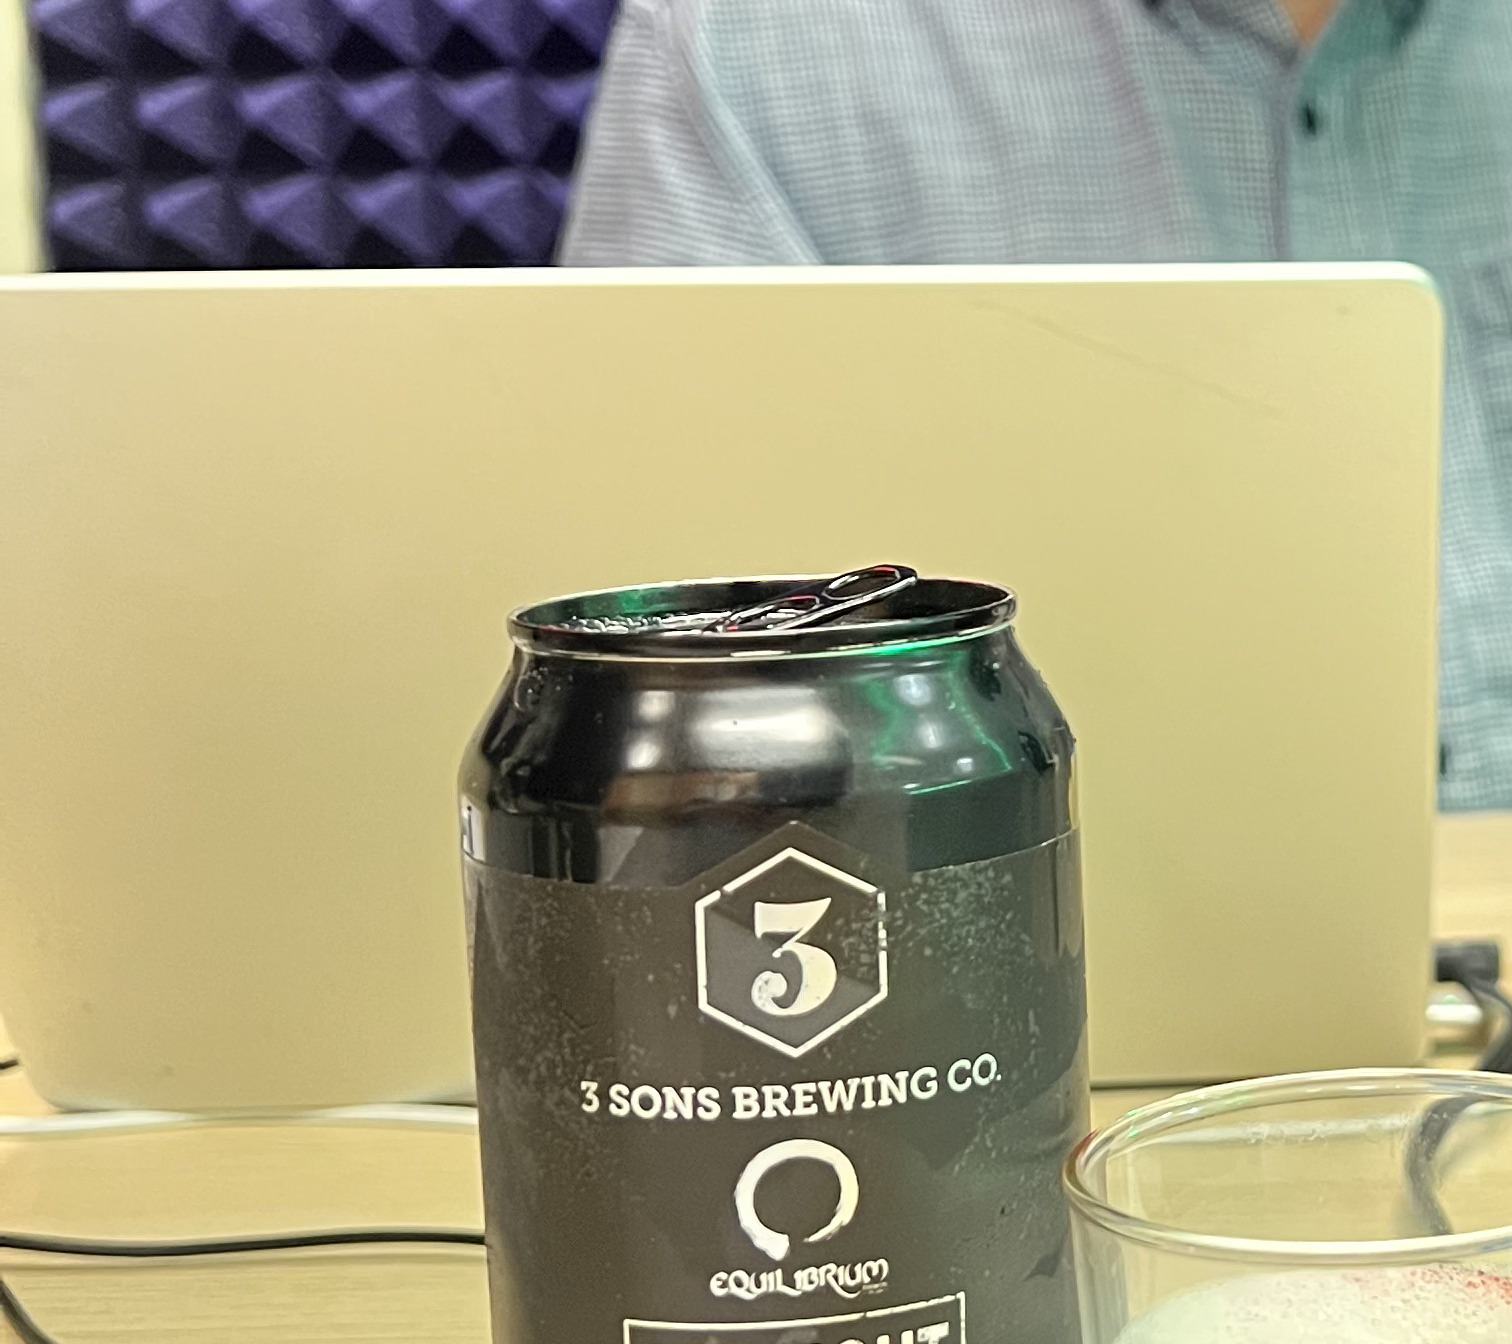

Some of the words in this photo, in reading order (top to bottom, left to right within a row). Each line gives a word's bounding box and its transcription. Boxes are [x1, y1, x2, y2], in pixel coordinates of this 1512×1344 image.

[751, 897, 838, 1016] 3
[580, 1080, 599, 1113] 3
[608, 1083, 721, 1121] SONS
[731, 1066, 938, 1119] BREWING
[947, 1052, 1002, 1092] CO.
[709, 1258, 889, 1300] EQUILIBRIUM
